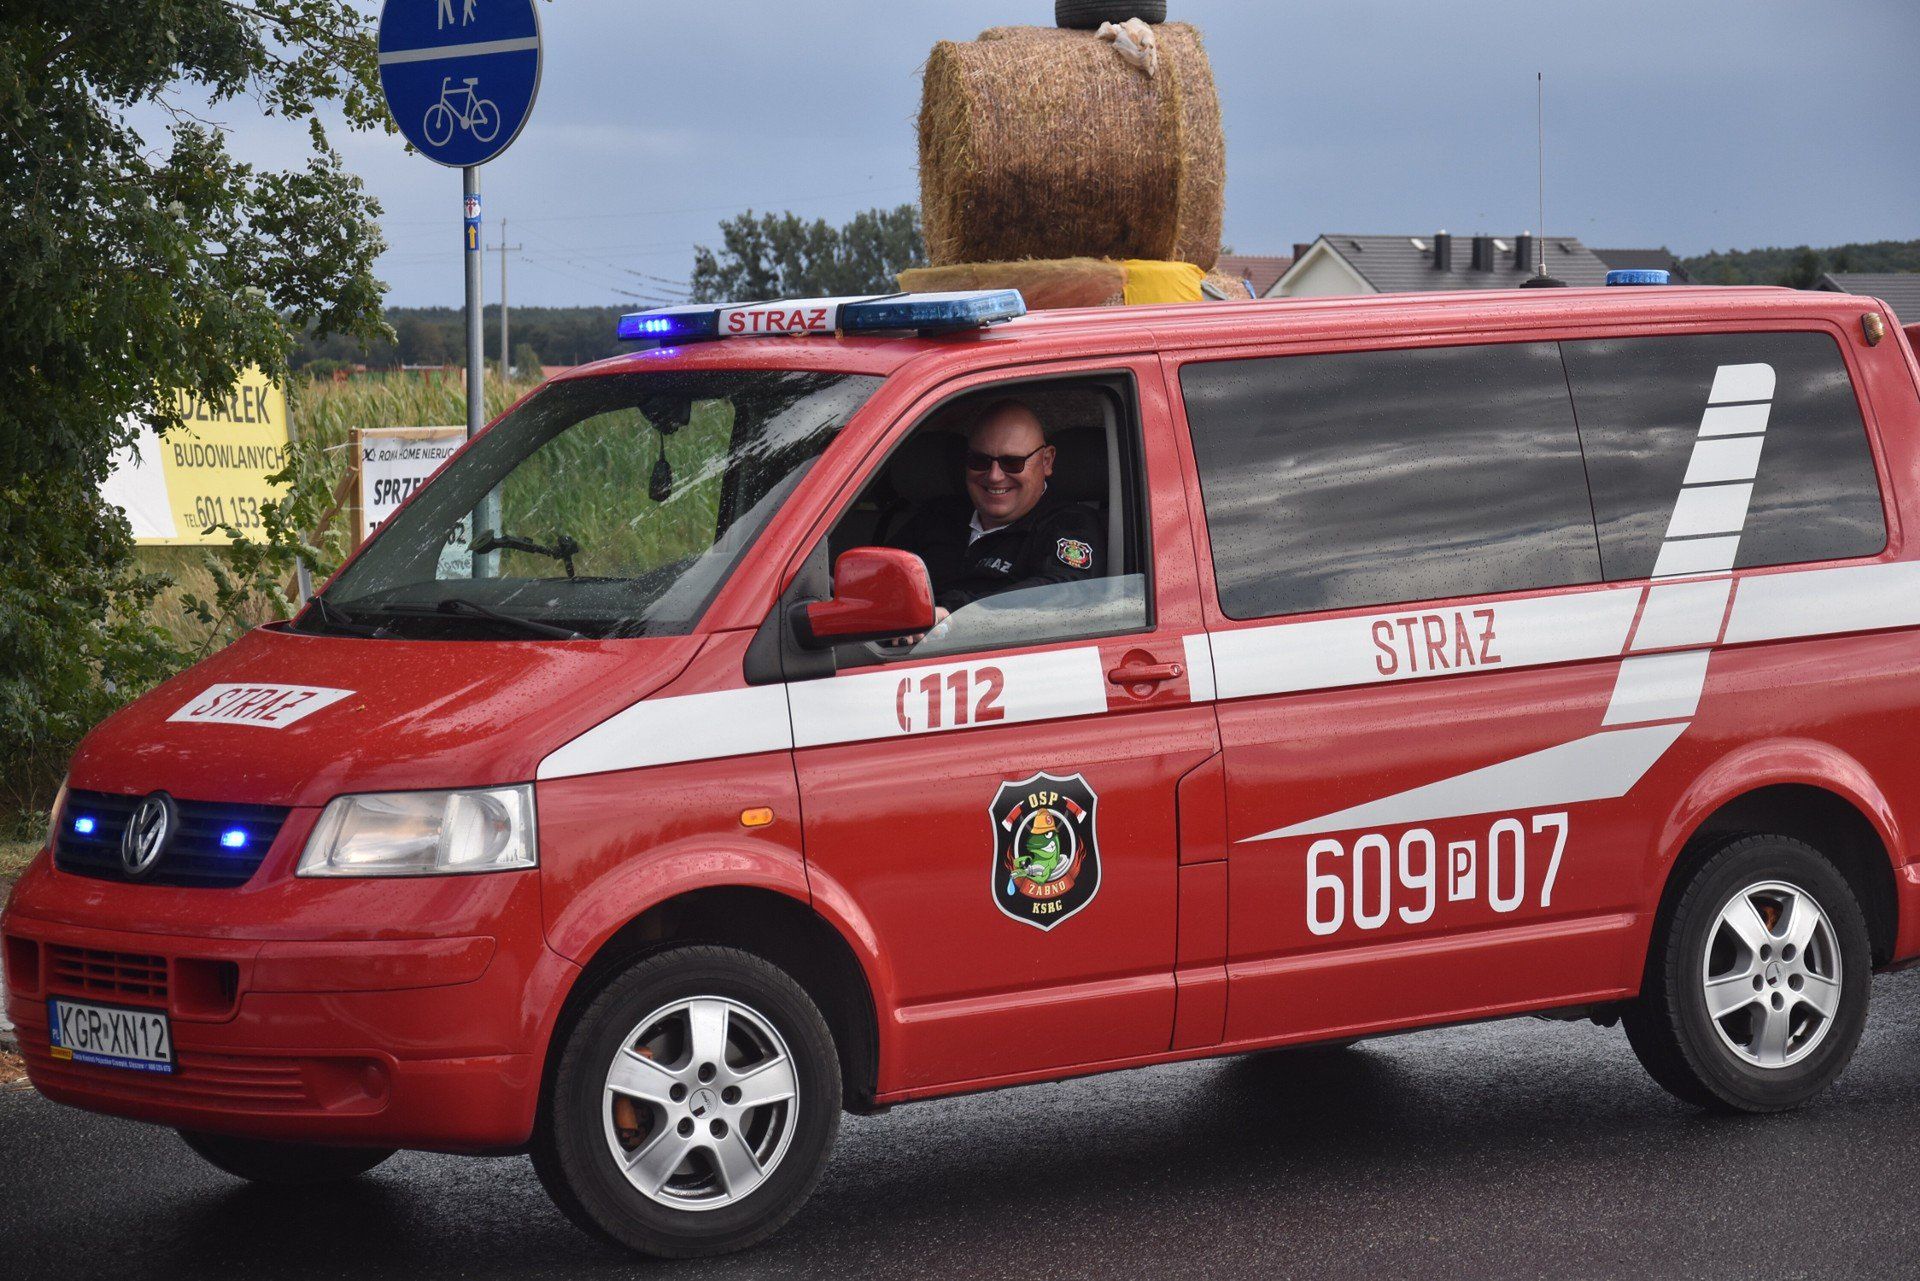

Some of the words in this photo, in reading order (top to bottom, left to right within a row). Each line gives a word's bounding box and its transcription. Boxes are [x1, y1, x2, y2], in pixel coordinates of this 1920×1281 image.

[174, 443, 285, 470] BUDOWLANYCH
[422, 447, 457, 460] NIERUC
[195, 496, 226, 528] 601
[230, 497, 260, 528] 153
[920, 666, 1005, 729] 112
[1028, 791, 1059, 808] OSP
[1306, 828, 1436, 936] 609
[1450, 843, 1474, 898] P
[1488, 811, 1568, 913] 07
[1032, 900, 1063, 914] KSRG
[60, 1006, 104, 1051] KGR
[108, 1012, 167, 1059] XN12
